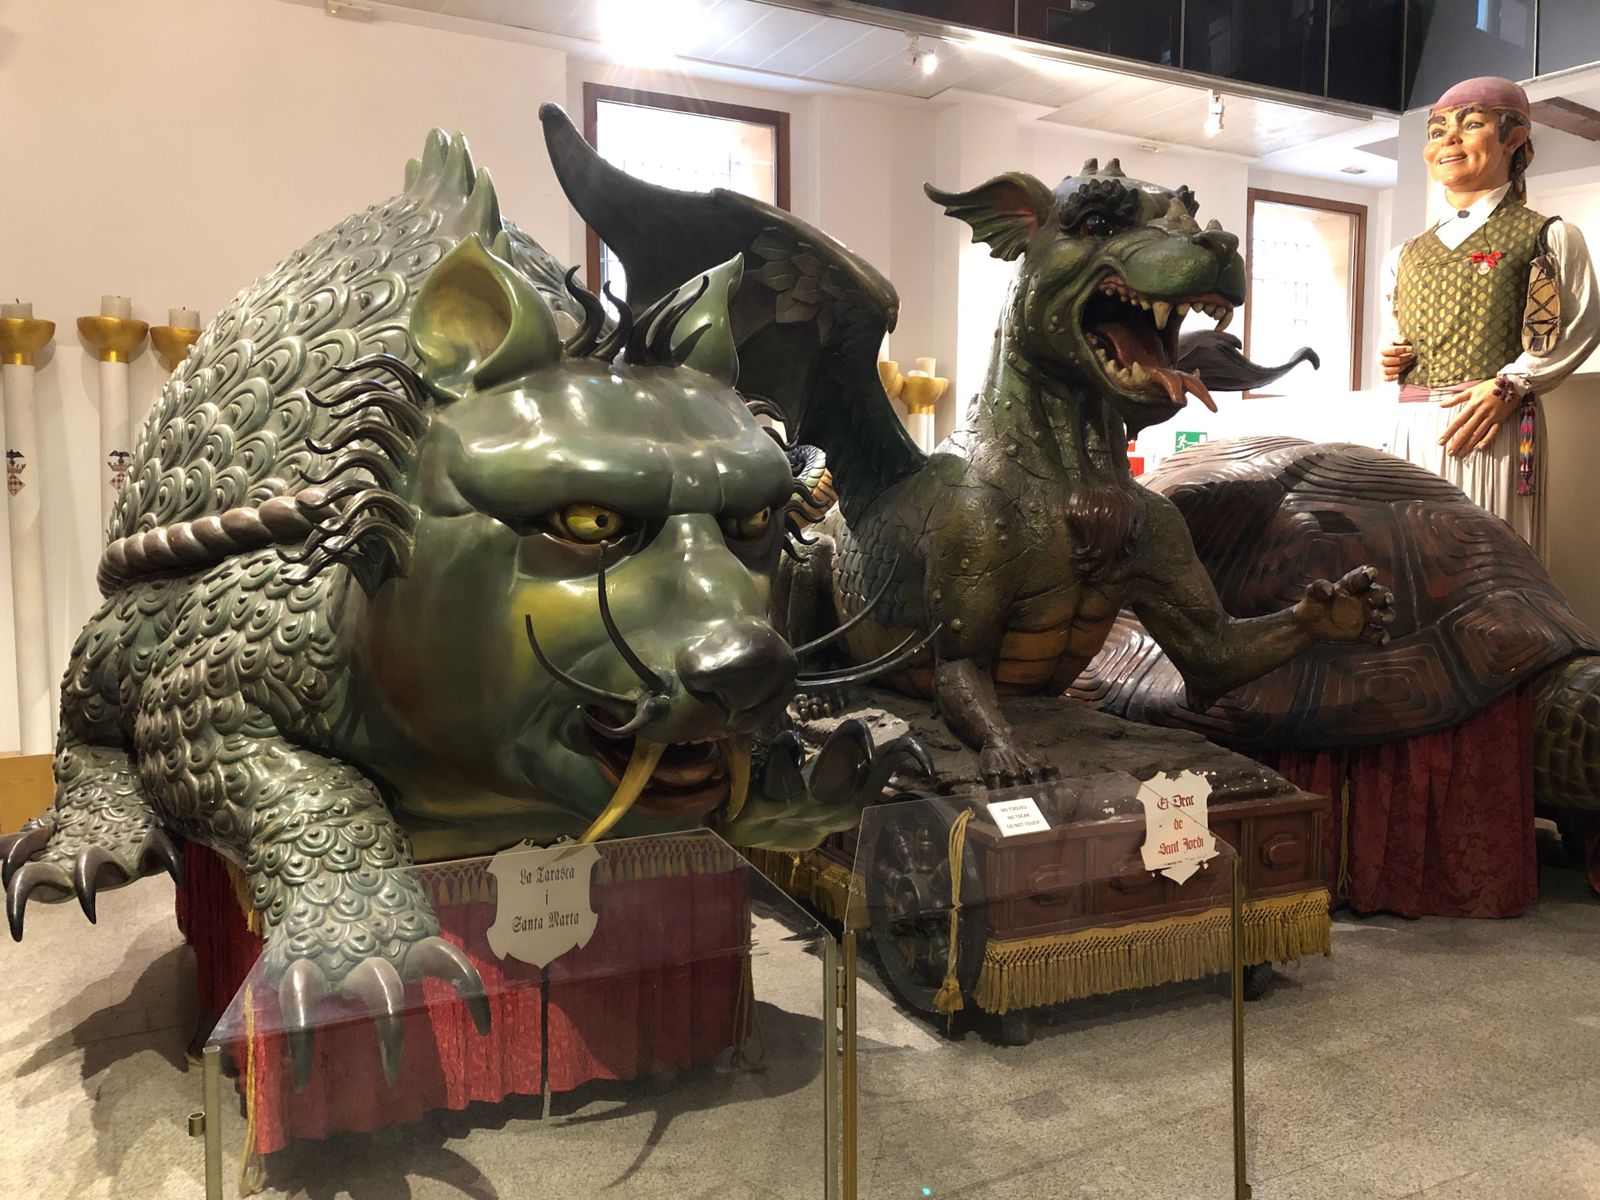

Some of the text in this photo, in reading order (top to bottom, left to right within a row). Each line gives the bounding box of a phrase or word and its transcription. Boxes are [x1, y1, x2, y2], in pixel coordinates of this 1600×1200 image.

[1157, 794, 1195, 811] El Drac
[1173, 818, 1184, 830] de
[1158, 836, 1204, 855] Sant Jordi
[520, 865, 575, 886] La Tarasca
[545, 889, 548, 906] i
[512, 911, 579, 933] Santa Marta
